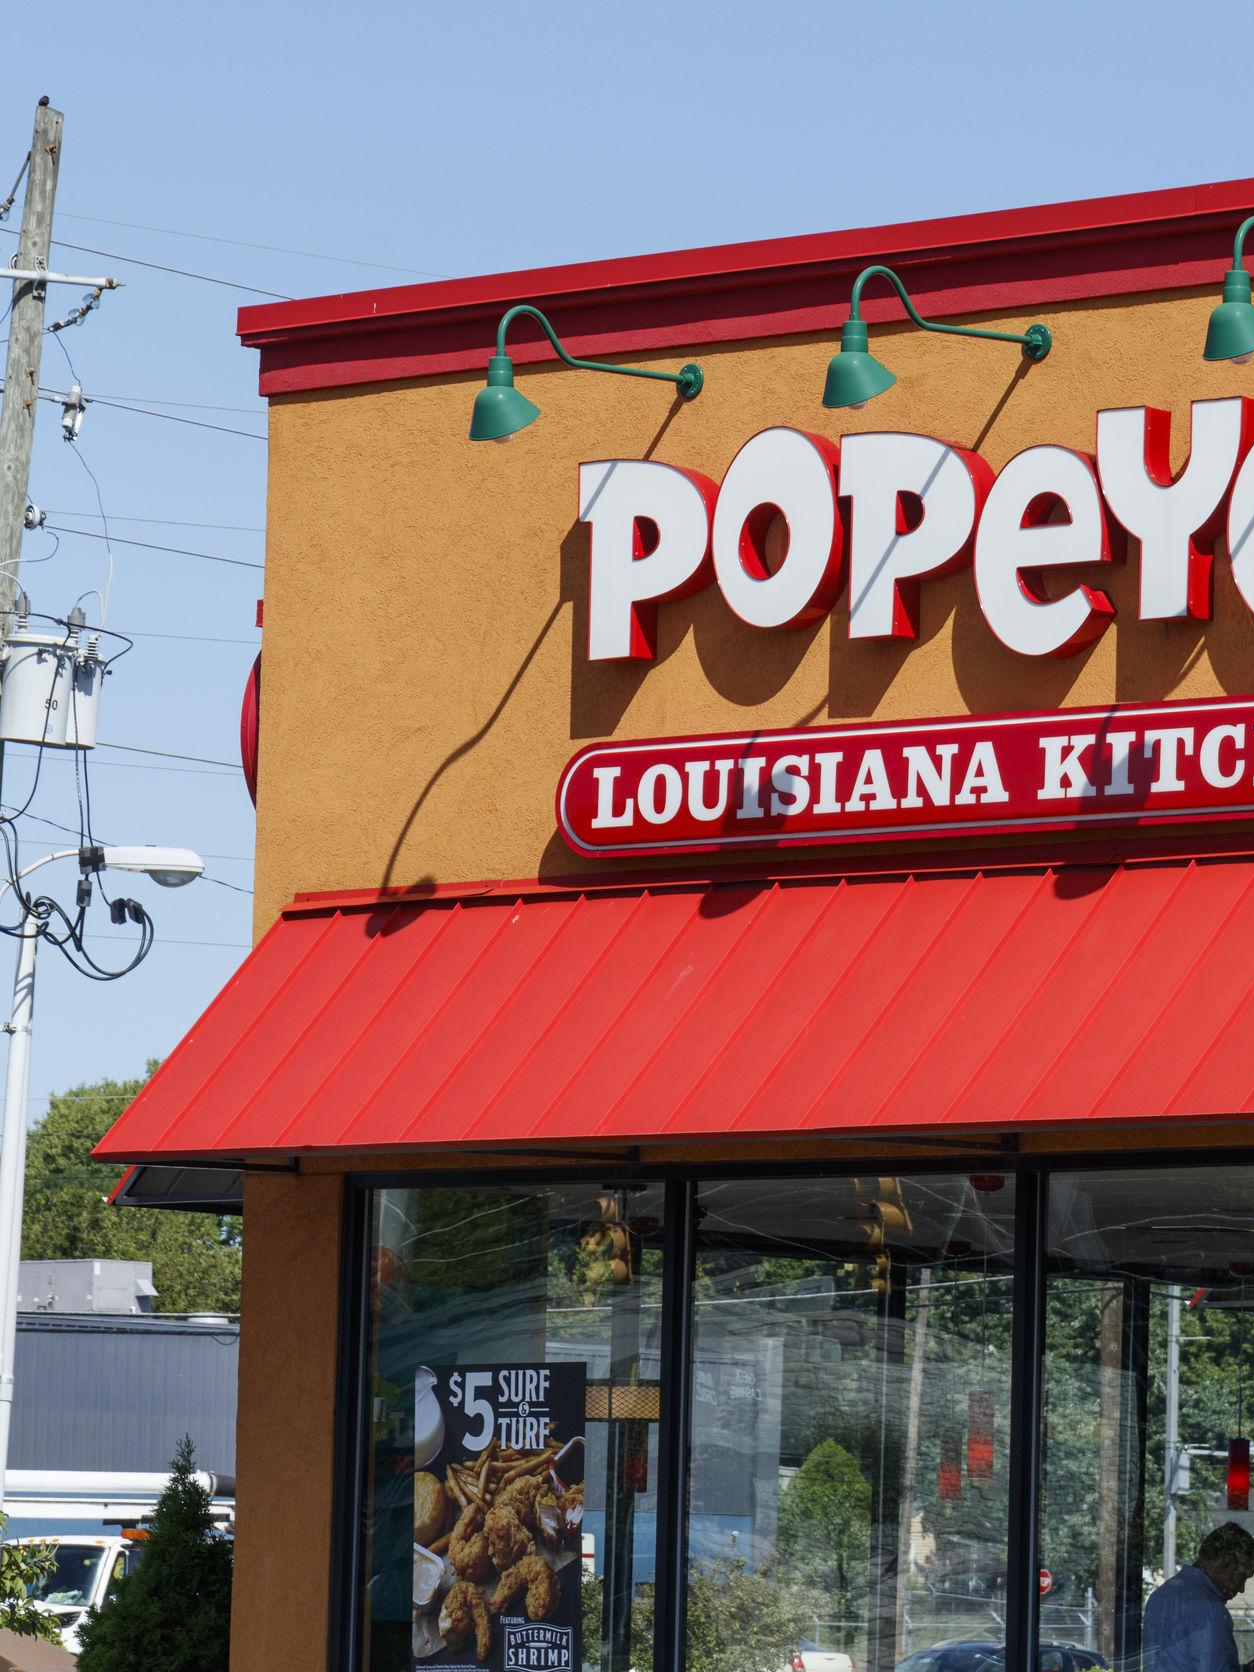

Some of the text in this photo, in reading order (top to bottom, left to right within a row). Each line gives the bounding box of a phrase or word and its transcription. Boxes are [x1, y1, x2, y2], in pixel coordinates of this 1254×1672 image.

[591, 741, 1010, 830] LOUISIANA
[498, 1369, 550, 1402] SURF
[498, 1417, 550, 1450] TURF
[509, 1629, 568, 1647] BUTTERMILK
[508, 1648, 569, 1667] SHRIMP
